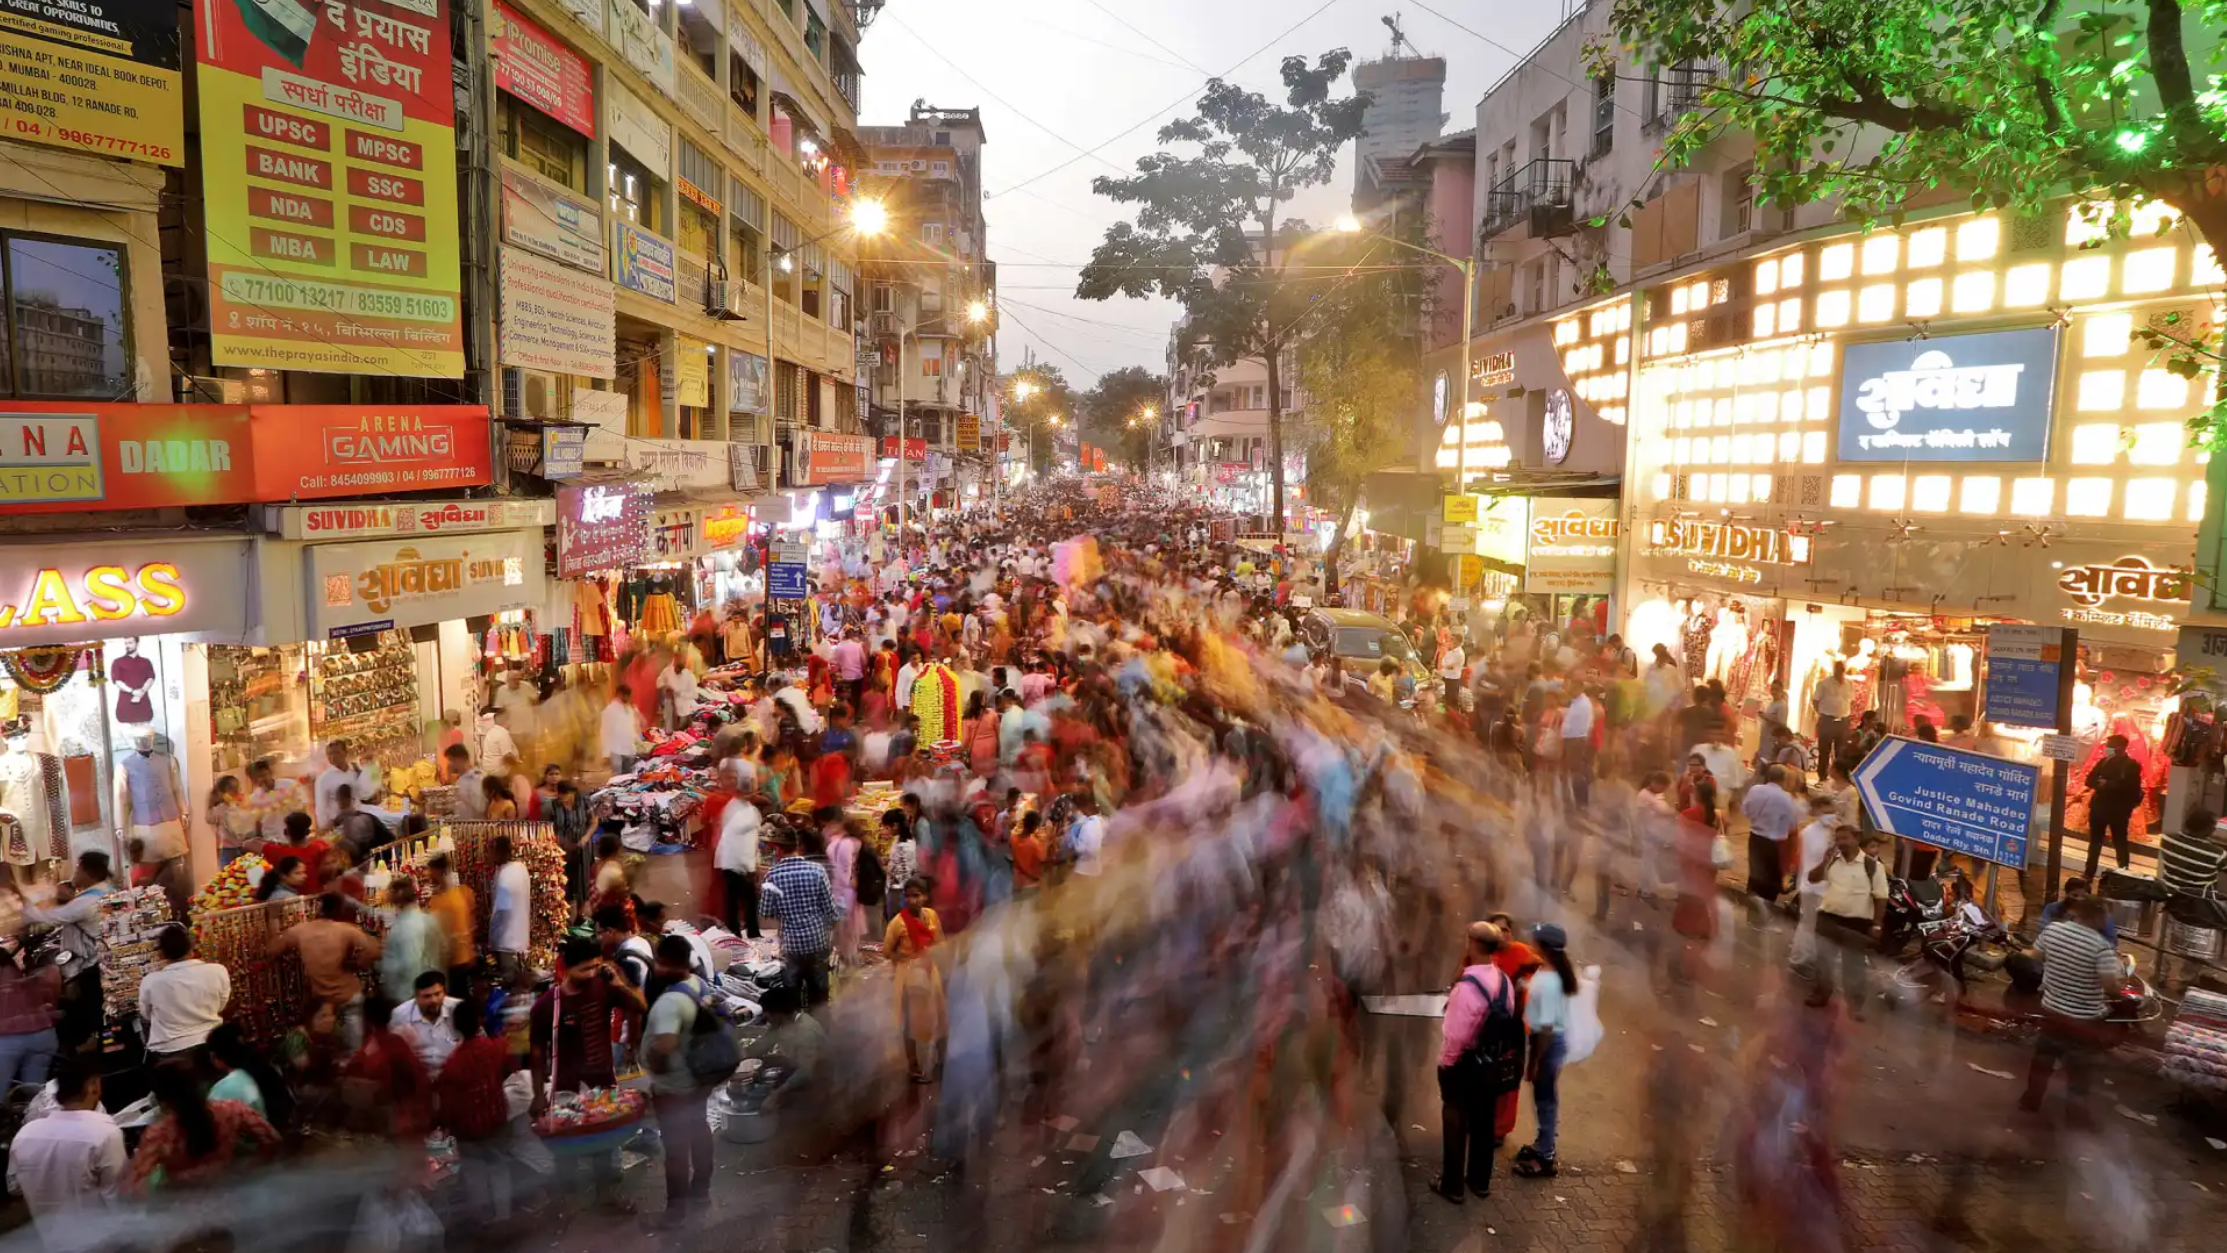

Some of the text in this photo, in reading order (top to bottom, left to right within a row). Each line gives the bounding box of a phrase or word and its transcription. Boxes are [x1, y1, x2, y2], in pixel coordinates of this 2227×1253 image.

[8, 0, 40, 13] GREAT
[90, 5, 102, 16] TO
[0, 15, 36, 29] ertified
[38, 25, 72, 40] gaming
[324, 0, 431, 54] द प्रयास
[507, 20, 561, 72] iPromise
[0, 43, 32, 60] ISHNA
[58, 57, 83, 71] NEAR
[86, 62, 111, 78] IDEAL
[114, 69, 138, 84] BOOK
[9, 62, 50, 80] MUMBAI
[337, 41, 423, 94] इंडिया
[0, 81, 39, 98] MILLAH
[72, 96, 83, 108] 12
[85, 99, 122, 115] RANADE
[15, 100, 34, 113] 400
[281, 79, 386, 122] स्पर्धा परीक्षा
[16, 119, 41, 135] 04
[58, 128, 171, 159] 9967777126
[259, 113, 316, 143] UPSC
[358, 136, 411, 163] MPSC
[259, 153, 319, 183] BANK
[368, 176, 405, 198] SSC
[271, 196, 312, 220] NDA
[369, 214, 406, 235] CDS
[270, 235, 316, 259] MBA
[368, 250, 410, 271] LAW
[508, 259, 541, 280] University
[577, 279, 590, 293] India
[508, 276, 546, 296] Professional
[245, 279, 294, 303] 77100
[301, 285, 345, 308] 13217
[358, 294, 401, 313] 83559
[406, 299, 448, 318] 51603
[246, 313, 276, 330] शॉप
[223, 344, 388, 366] www.theprayasindia.com
[1470, 350, 1515, 378] SUVIDHA
[1856, 350, 2025, 429] सुविधा
[360, 416, 422, 432] ARENA
[0, 425, 88, 456] NA
[331, 434, 449, 462] GAMING
[885, 446, 924, 458] TIAN
[119, 440, 231, 473] DADAR
[300, 475, 327, 488] Call:
[330, 471, 394, 486] 8454099903
[402, 470, 415, 482] 04
[422, 467, 476, 481] 9967777126
[307, 508, 391, 531] SUVIDHA
[1665, 519, 1796, 566] SUVIDHA
[357, 546, 463, 614] सुविधा
[1913, 751, 1957, 770] न्यायमूर्ती
[1959, 761, 1995, 778] महादेव
[1914, 786, 2026, 820] Justice Mahadeo
[1974, 782, 2004, 797] रानडे
[1888, 791, 2026, 833] Govind Ranade Road
[1923, 830, 1951, 844] Dadar
[1973, 844, 1992, 856] Stn.
